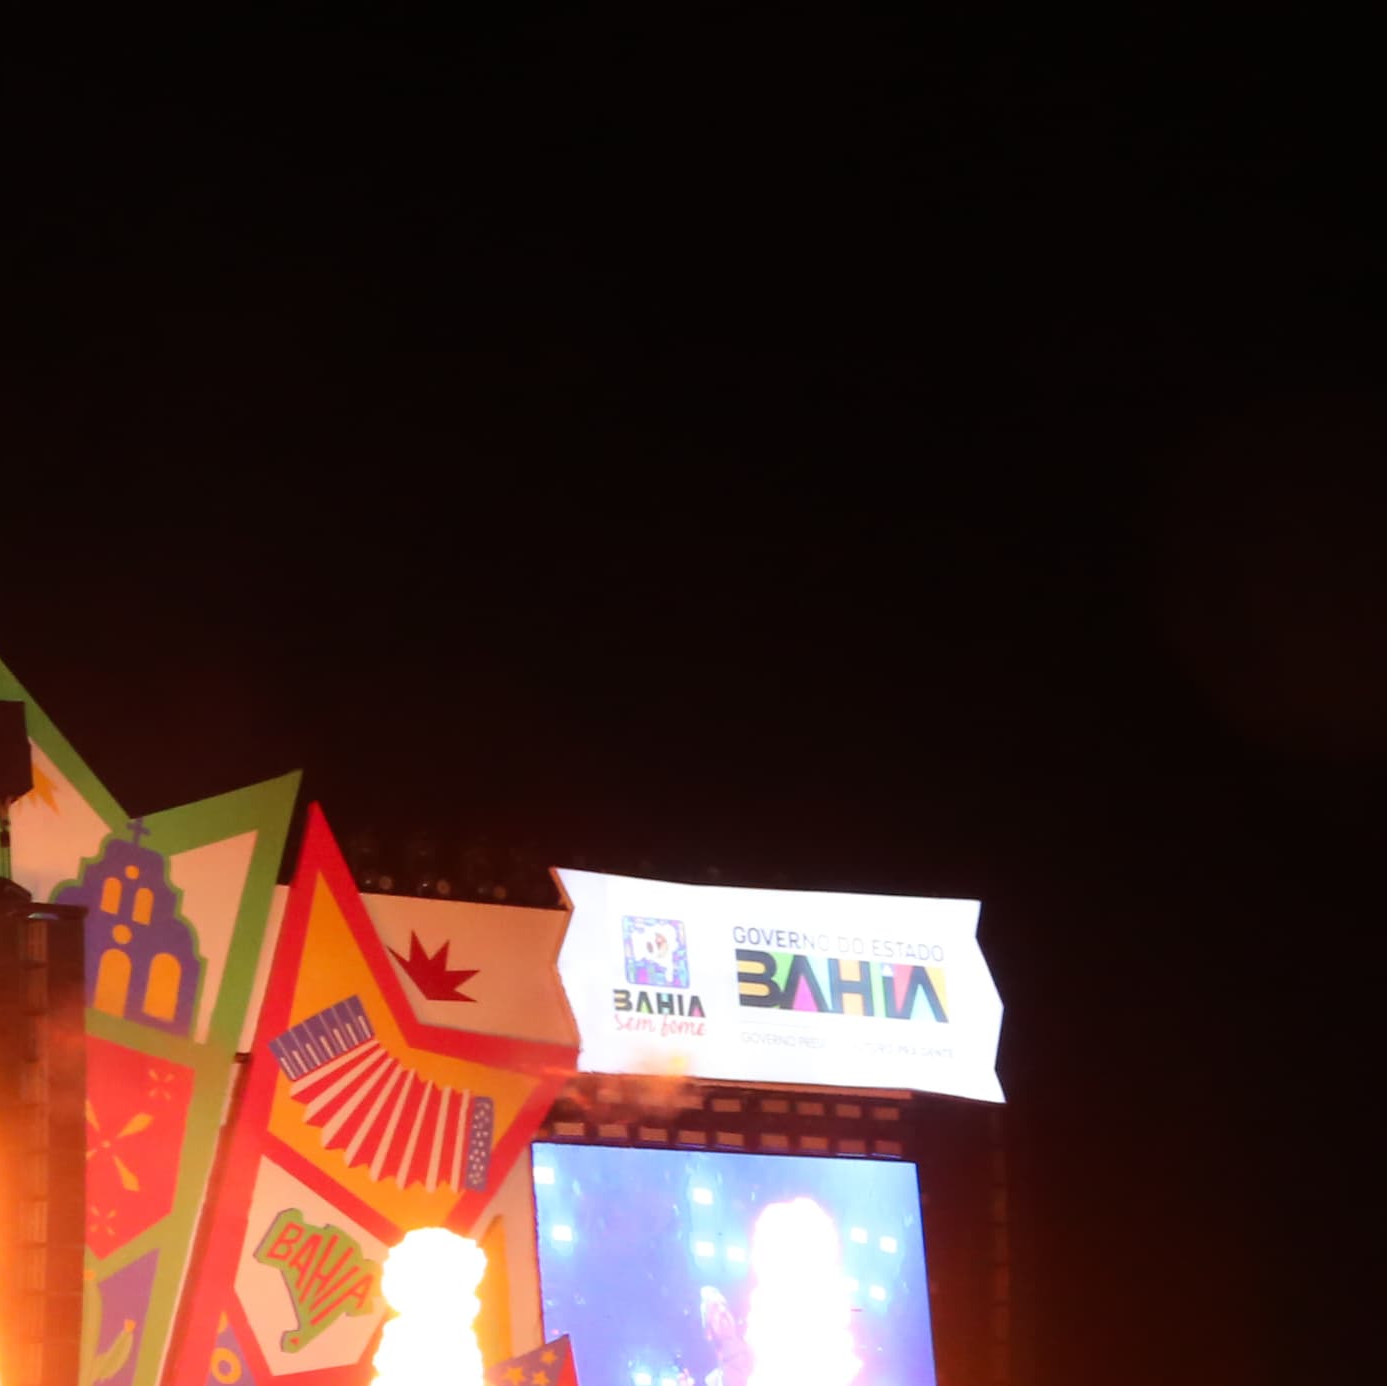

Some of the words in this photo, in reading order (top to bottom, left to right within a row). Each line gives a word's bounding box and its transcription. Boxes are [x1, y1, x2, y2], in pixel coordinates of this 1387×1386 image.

[613, 989, 706, 1018] BAHIA
[736, 948, 949, 1024] BAHIA
[268, 1222, 375, 1326] BAHIA
